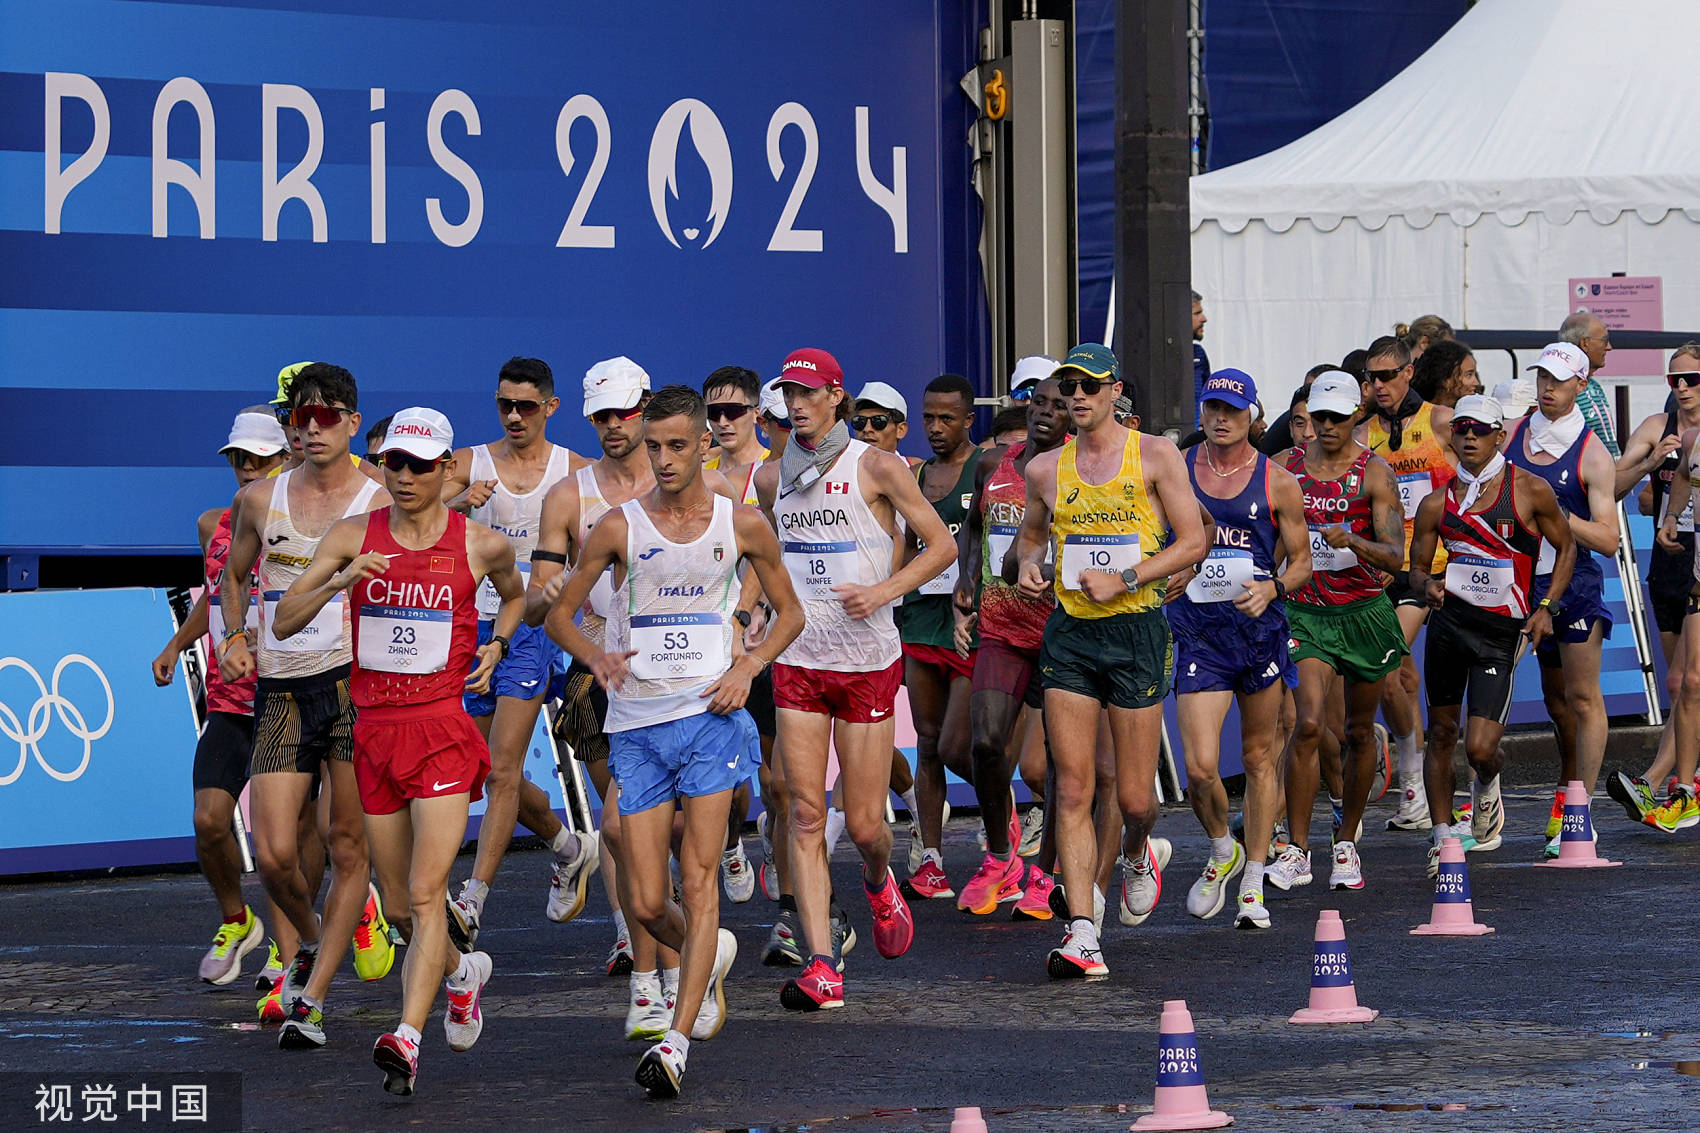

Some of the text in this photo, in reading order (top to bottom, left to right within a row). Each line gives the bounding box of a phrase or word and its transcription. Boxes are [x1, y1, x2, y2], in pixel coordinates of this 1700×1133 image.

[45, 71, 908, 254] PARIS 2024
[782, 360, 817, 371] CANADA
[1207, 378, 1245, 395] FRANCE
[394, 424, 432, 437] CHINA
[1389, 458, 1428, 472] MANY
[1303, 493, 1349, 512] ÉXICO
[781, 509, 848, 529] CANADA
[988, 502, 1026, 523] KEN
[1071, 511, 1137, 524] AUSTRALIA
[1214, 525, 1252, 548] NCE
[265, 551, 313, 569] ESPA
[1089, 550, 1111, 566] 10
[809, 559, 826, 575] 18
[1205, 564, 1226, 579] 38
[805, 577, 832, 585] DUNFEE
[1201, 580, 1232, 588] QUINION
[1471, 570, 1490, 584] 68
[366, 578, 453, 610] CHINA
[657, 585, 705, 597] ITALIA
[391, 626, 416, 644] 23
[664, 631, 689, 650] 53
[388, 646, 418, 656] ZHANG
[651, 651, 703, 662] FORTUNATO
[1563, 815, 1585, 824] ARIS
[1563, 824, 1585, 832] 024
[1314, 952, 1347, 964] PARIS
[1314, 965, 1348, 976] 2024
[1160, 1048, 1197, 1060] PARIS
[1160, 1061, 1198, 1073] 2024
